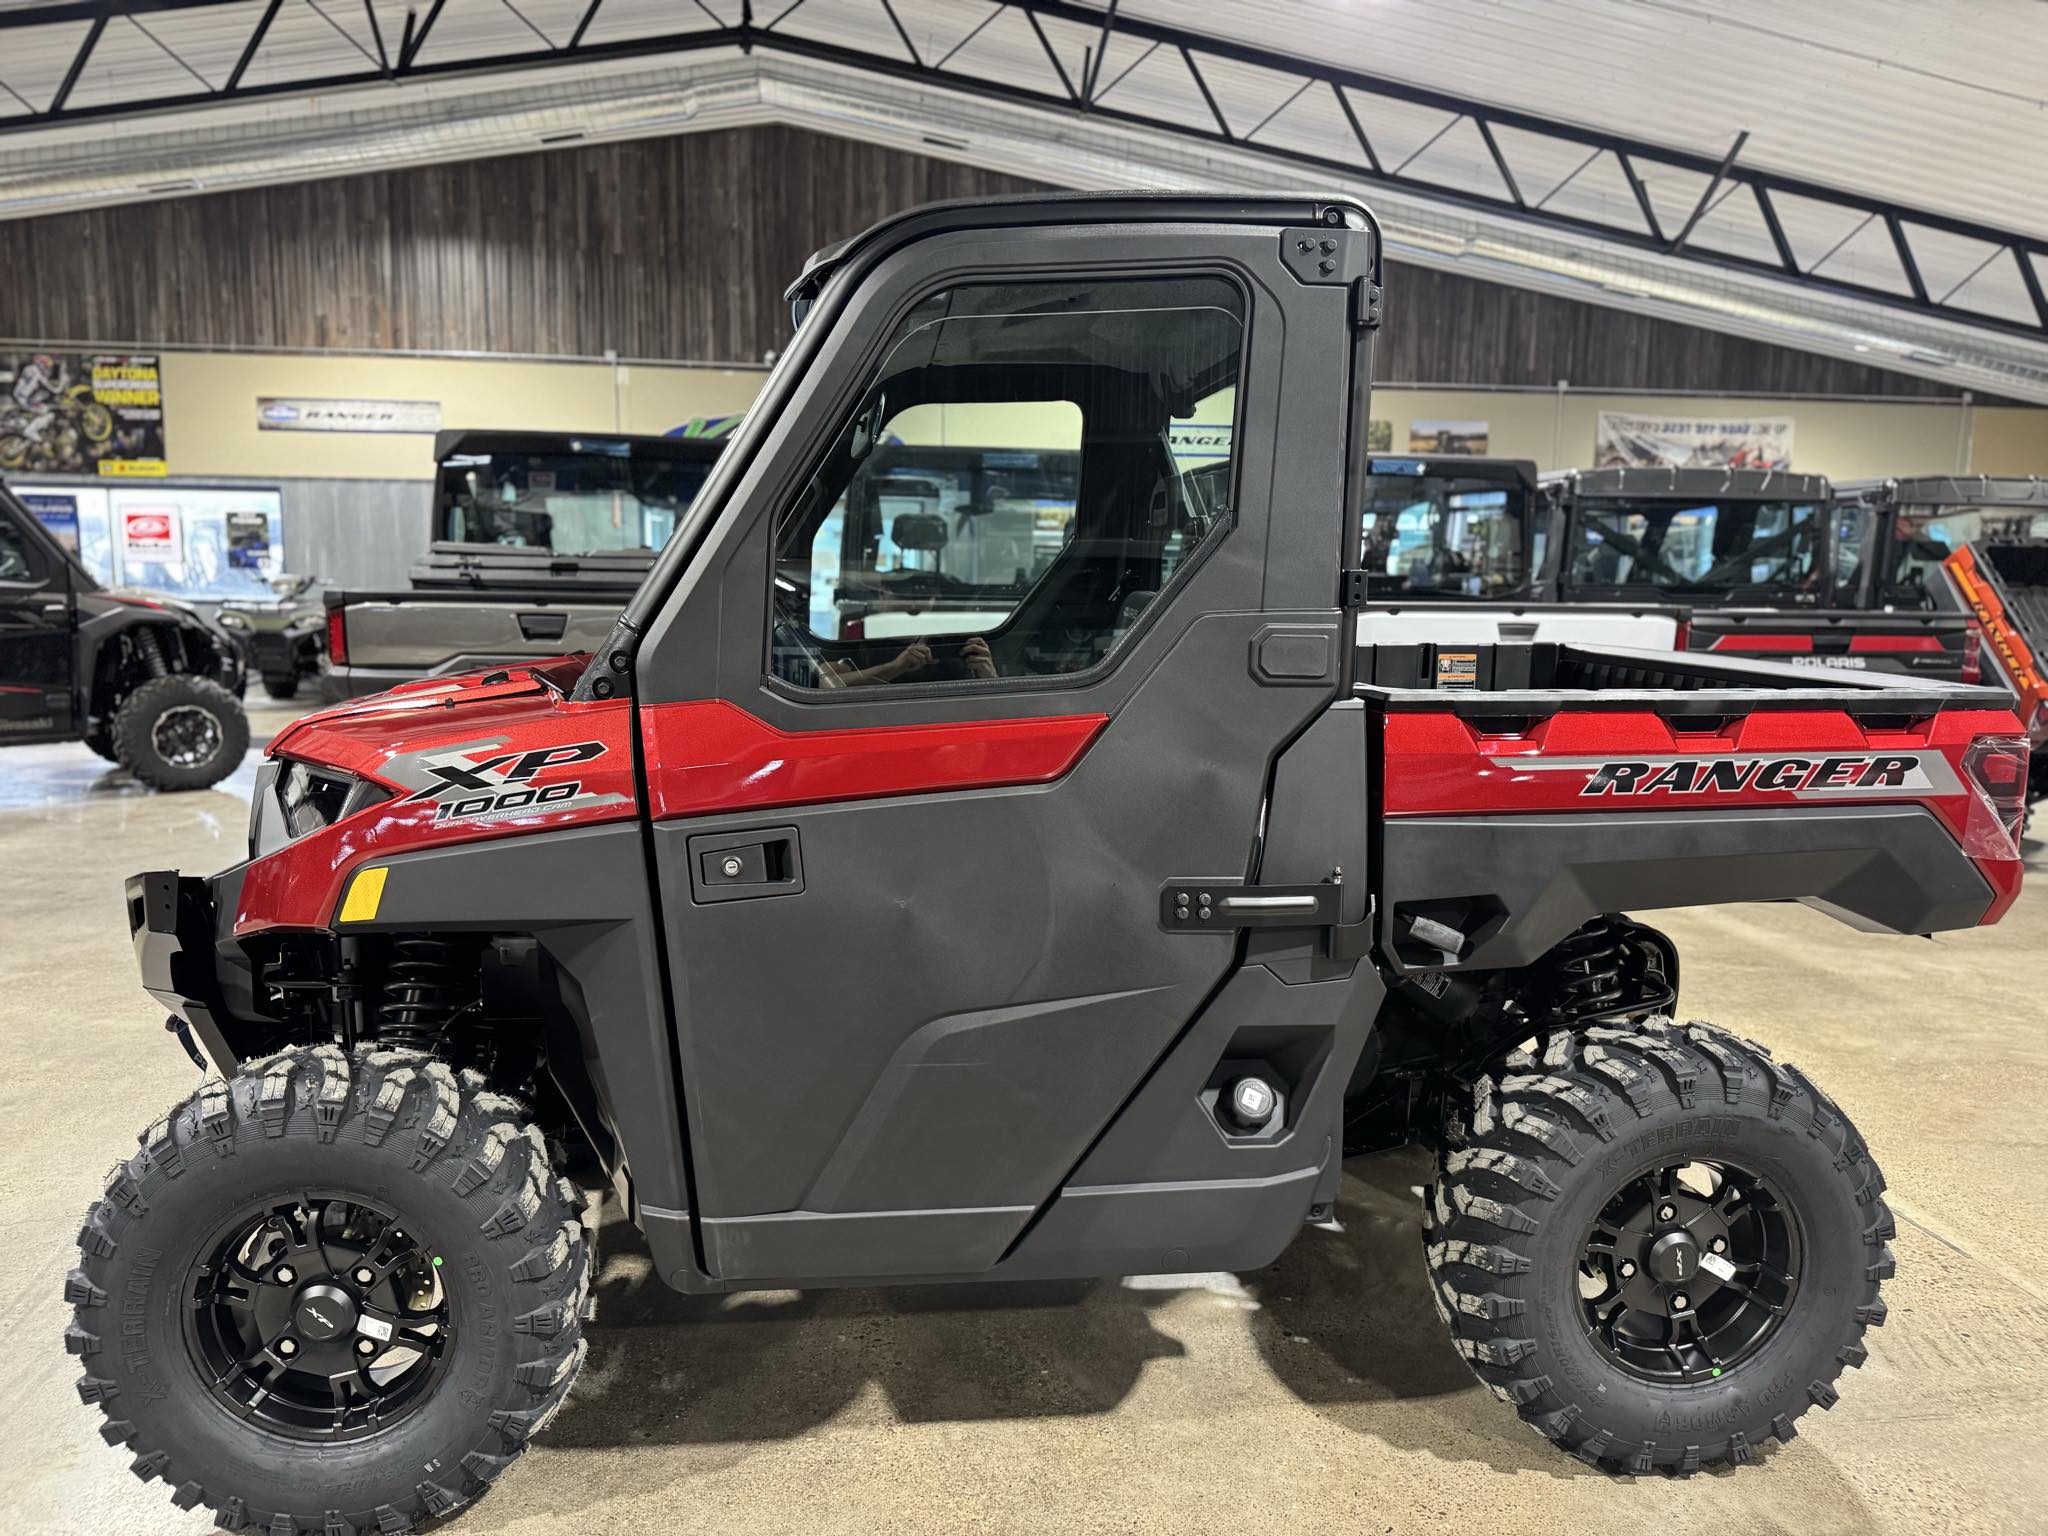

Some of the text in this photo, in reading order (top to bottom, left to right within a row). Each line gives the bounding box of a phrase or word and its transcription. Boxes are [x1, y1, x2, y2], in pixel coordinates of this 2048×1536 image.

[306, 411, 394, 420] RANGER
[1169, 436, 1231, 446] ANGE
[1792, 657, 1866, 669] POLARIS
[392, 740, 609, 807] XP
[1579, 755, 1921, 796] RANGER
[433, 781, 582, 822] 1000
[433, 801, 573, 830] DUAL OVERHEAD CAM
[305, 1307, 334, 1329] XP
